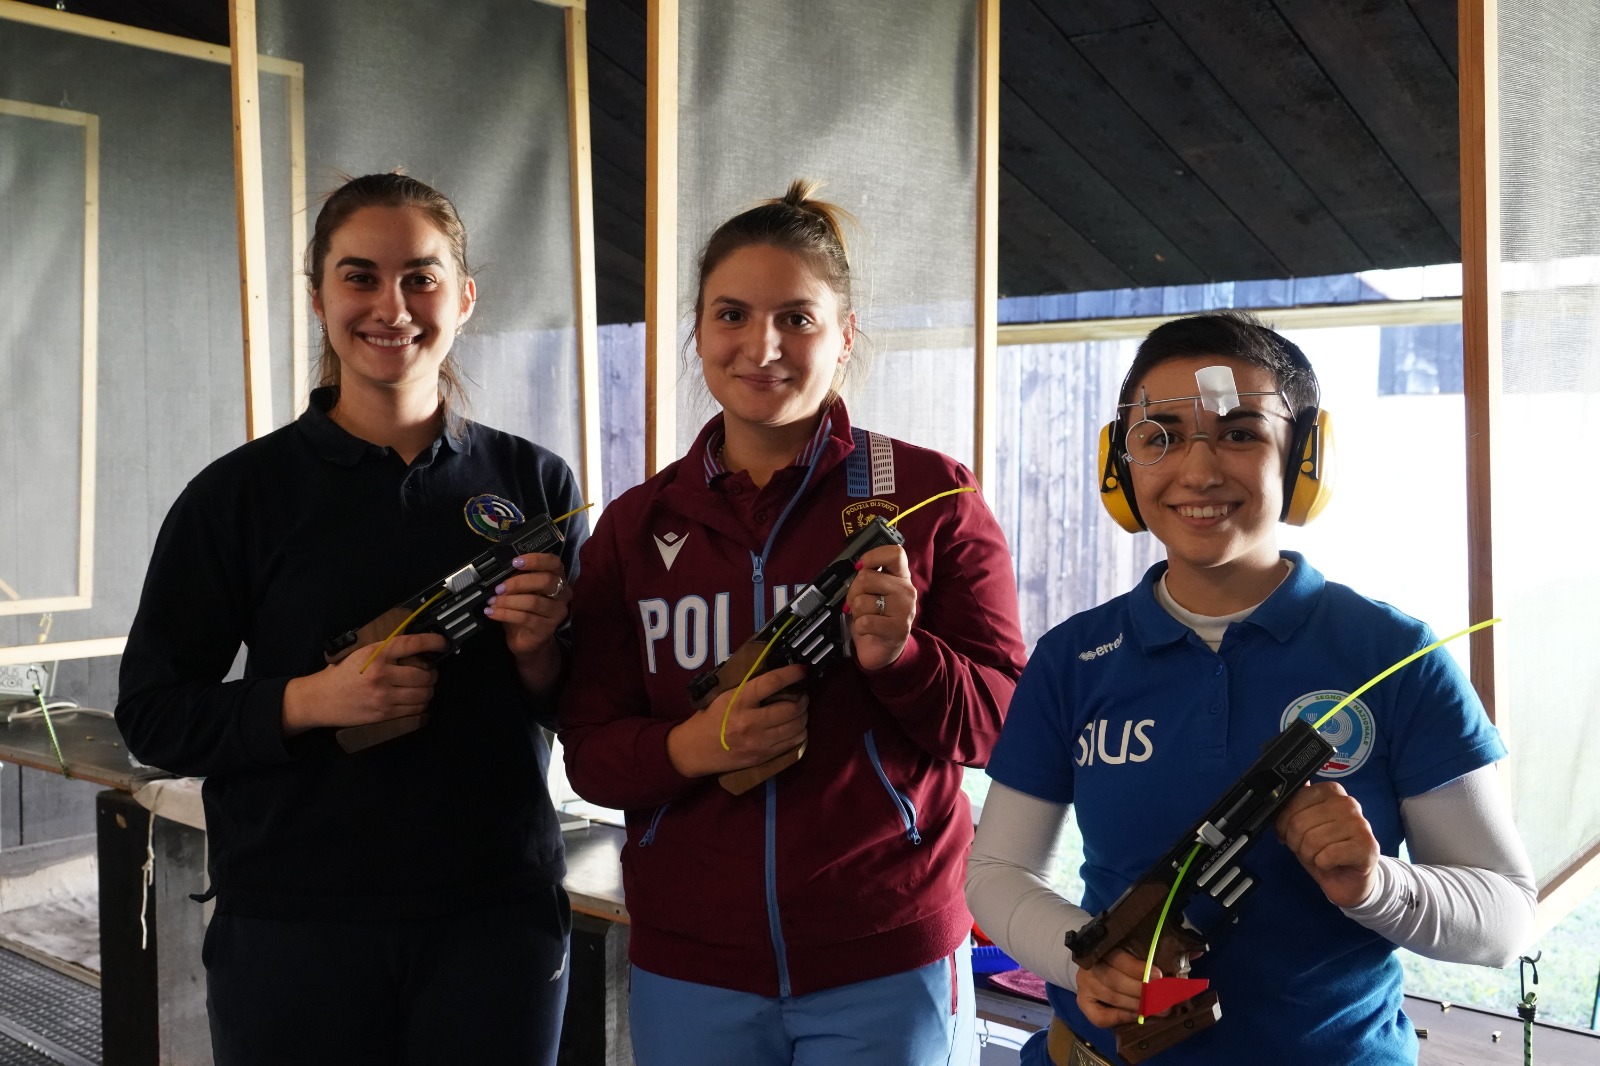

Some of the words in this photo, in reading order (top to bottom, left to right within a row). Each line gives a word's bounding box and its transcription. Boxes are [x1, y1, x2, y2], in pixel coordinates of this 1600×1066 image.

[846, 502, 870, 515] POLIZIA
[877, 502, 895, 511] STATO
[846, 522, 854, 534] FIA
[1353, 704, 1370, 746] NAZIONALE
[1074, 718, 1156, 768] SIUS
